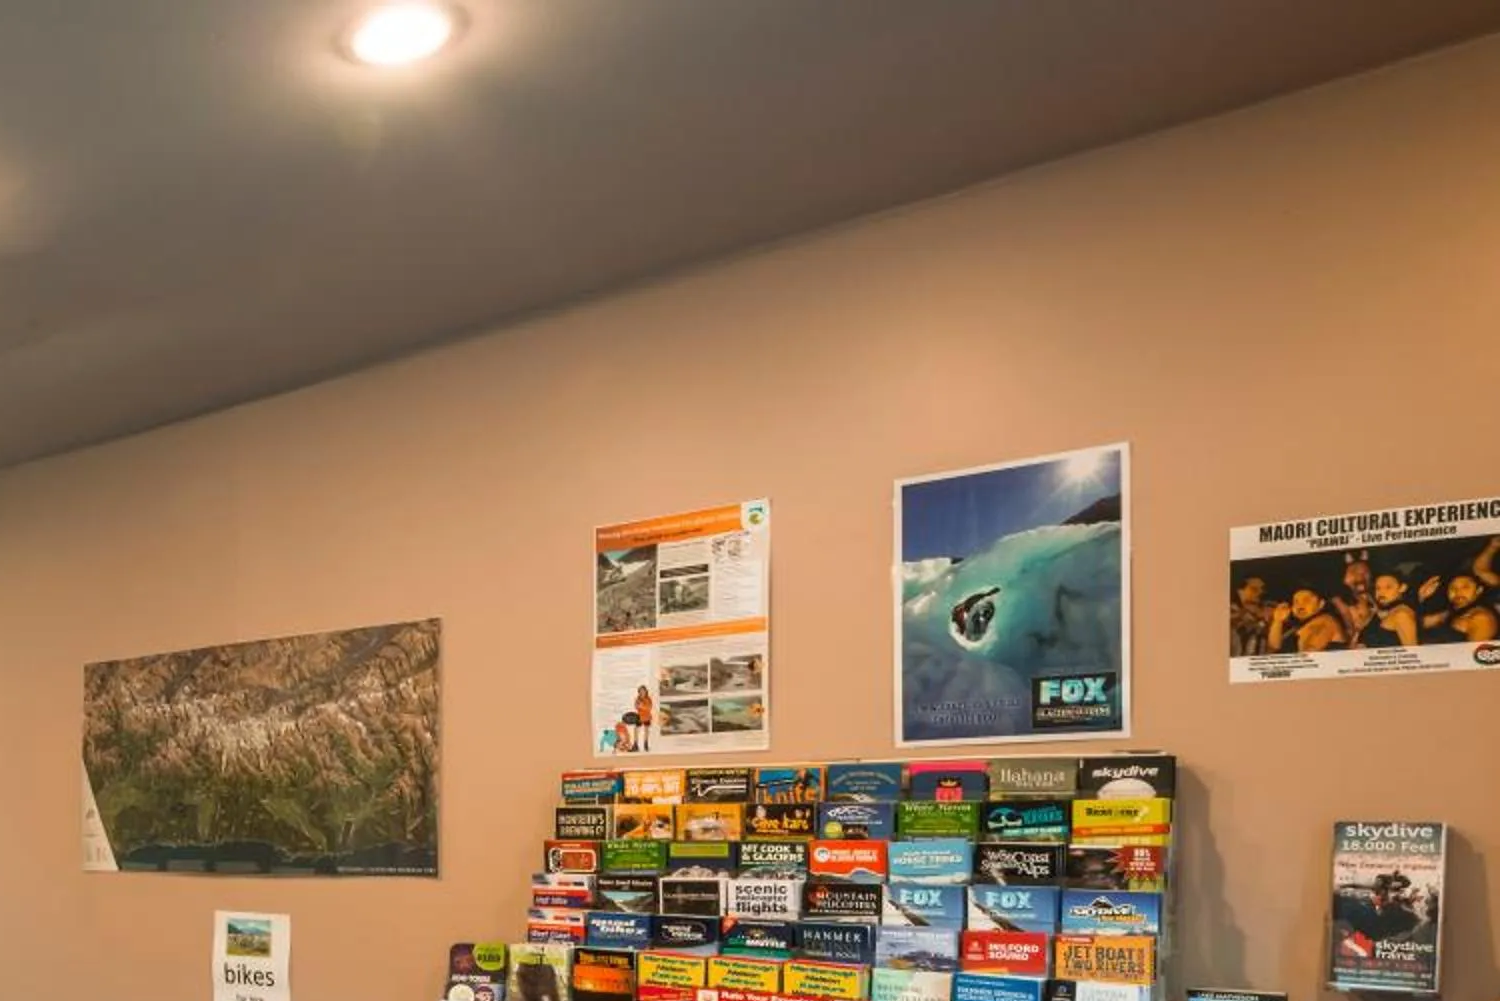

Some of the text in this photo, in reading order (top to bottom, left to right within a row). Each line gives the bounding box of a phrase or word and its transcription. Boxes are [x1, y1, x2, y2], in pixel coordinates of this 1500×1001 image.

[1259, 524, 1313, 543] MAORI
[1316, 511, 1400, 536] CULTURAL
[1385, 525, 1458, 541] Performance
[1040, 677, 1106, 705] FOX
[1092, 764, 1159, 779] skydive
[1345, 822, 1434, 841] skydive
[1401, 841, 1437, 854] Feet
[735, 884, 788, 896] scenic
[899, 888, 943, 907] FOX
[735, 900, 789, 916] flights
[985, 891, 1034, 909] FOX
[803, 930, 862, 943] HANMER
[1375, 939, 1434, 954] skydive
[1375, 948, 1416, 961] franz
[224, 962, 275, 987] bikes
